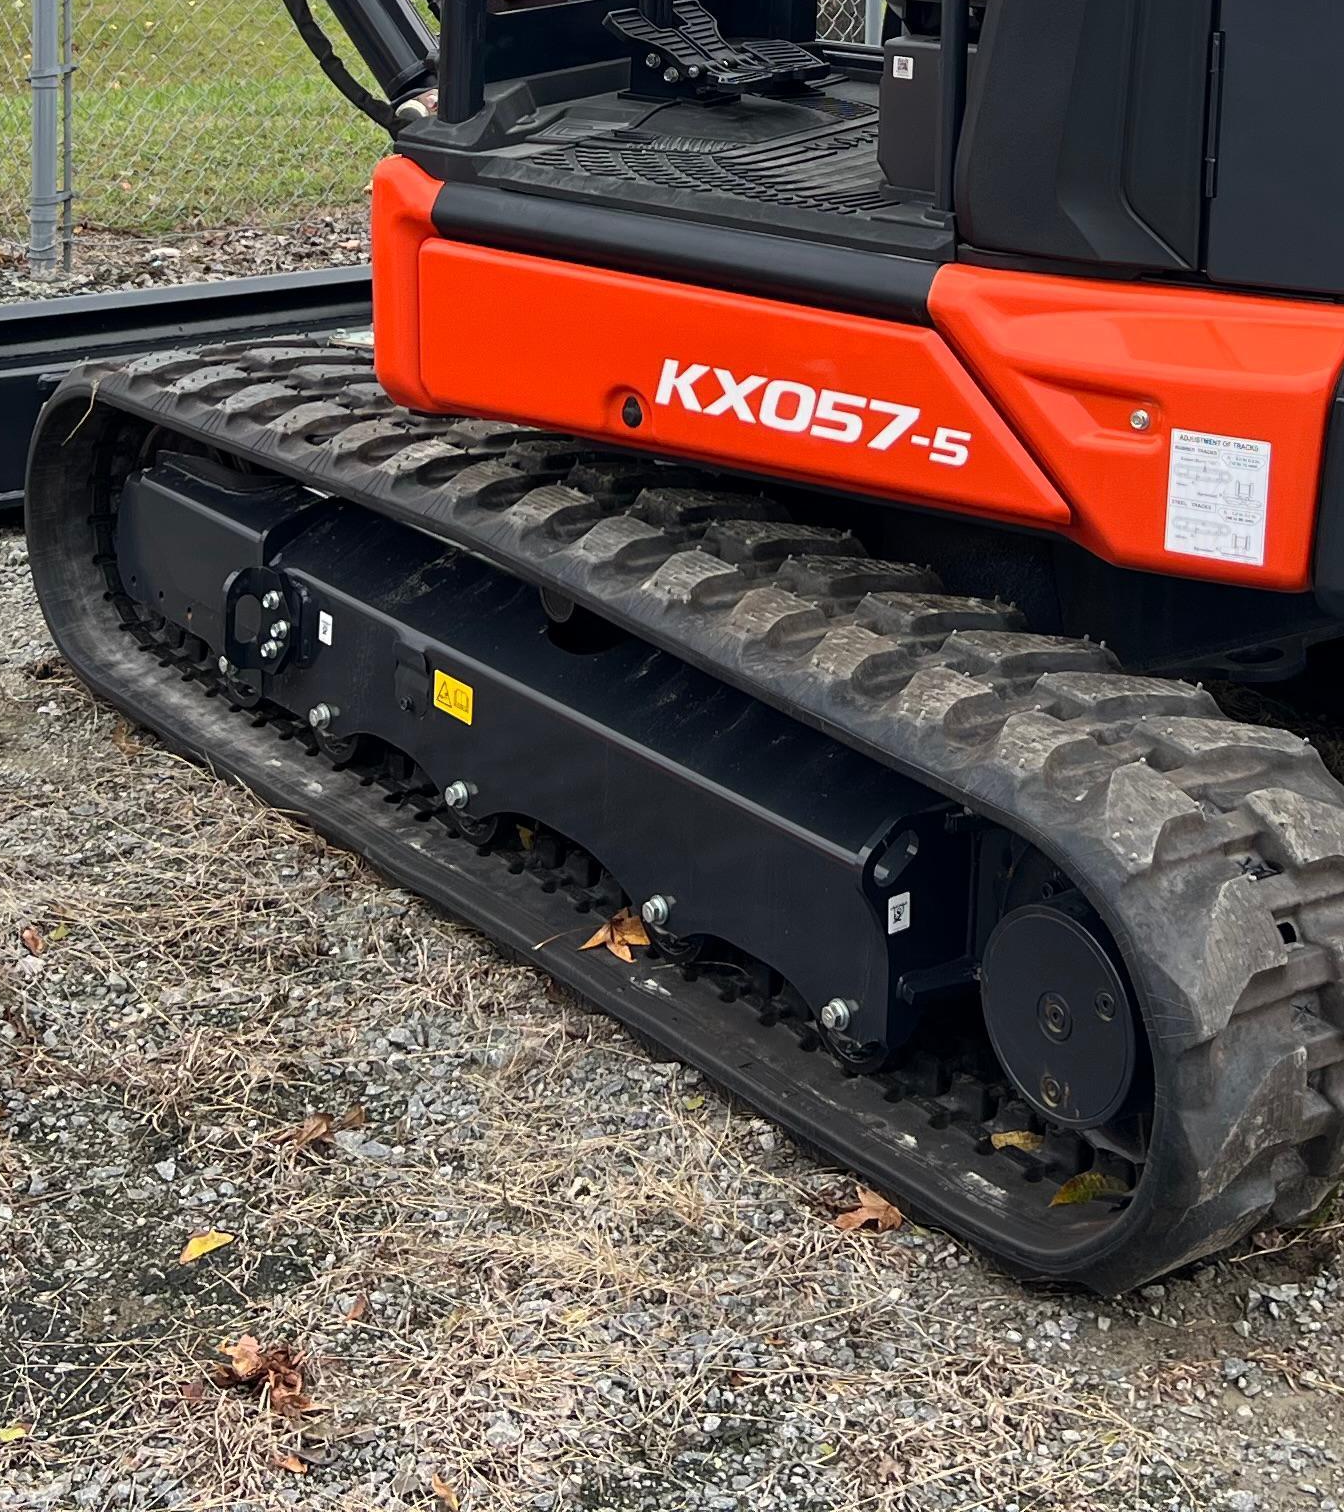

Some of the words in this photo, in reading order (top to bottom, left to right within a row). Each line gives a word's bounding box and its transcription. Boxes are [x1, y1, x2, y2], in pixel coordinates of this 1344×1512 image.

[655, 358, 972, 466] KX057-5
[1179, 433, 1221, 447] ADJUSTMENT
[1233, 442, 1259, 452] TRACKS
